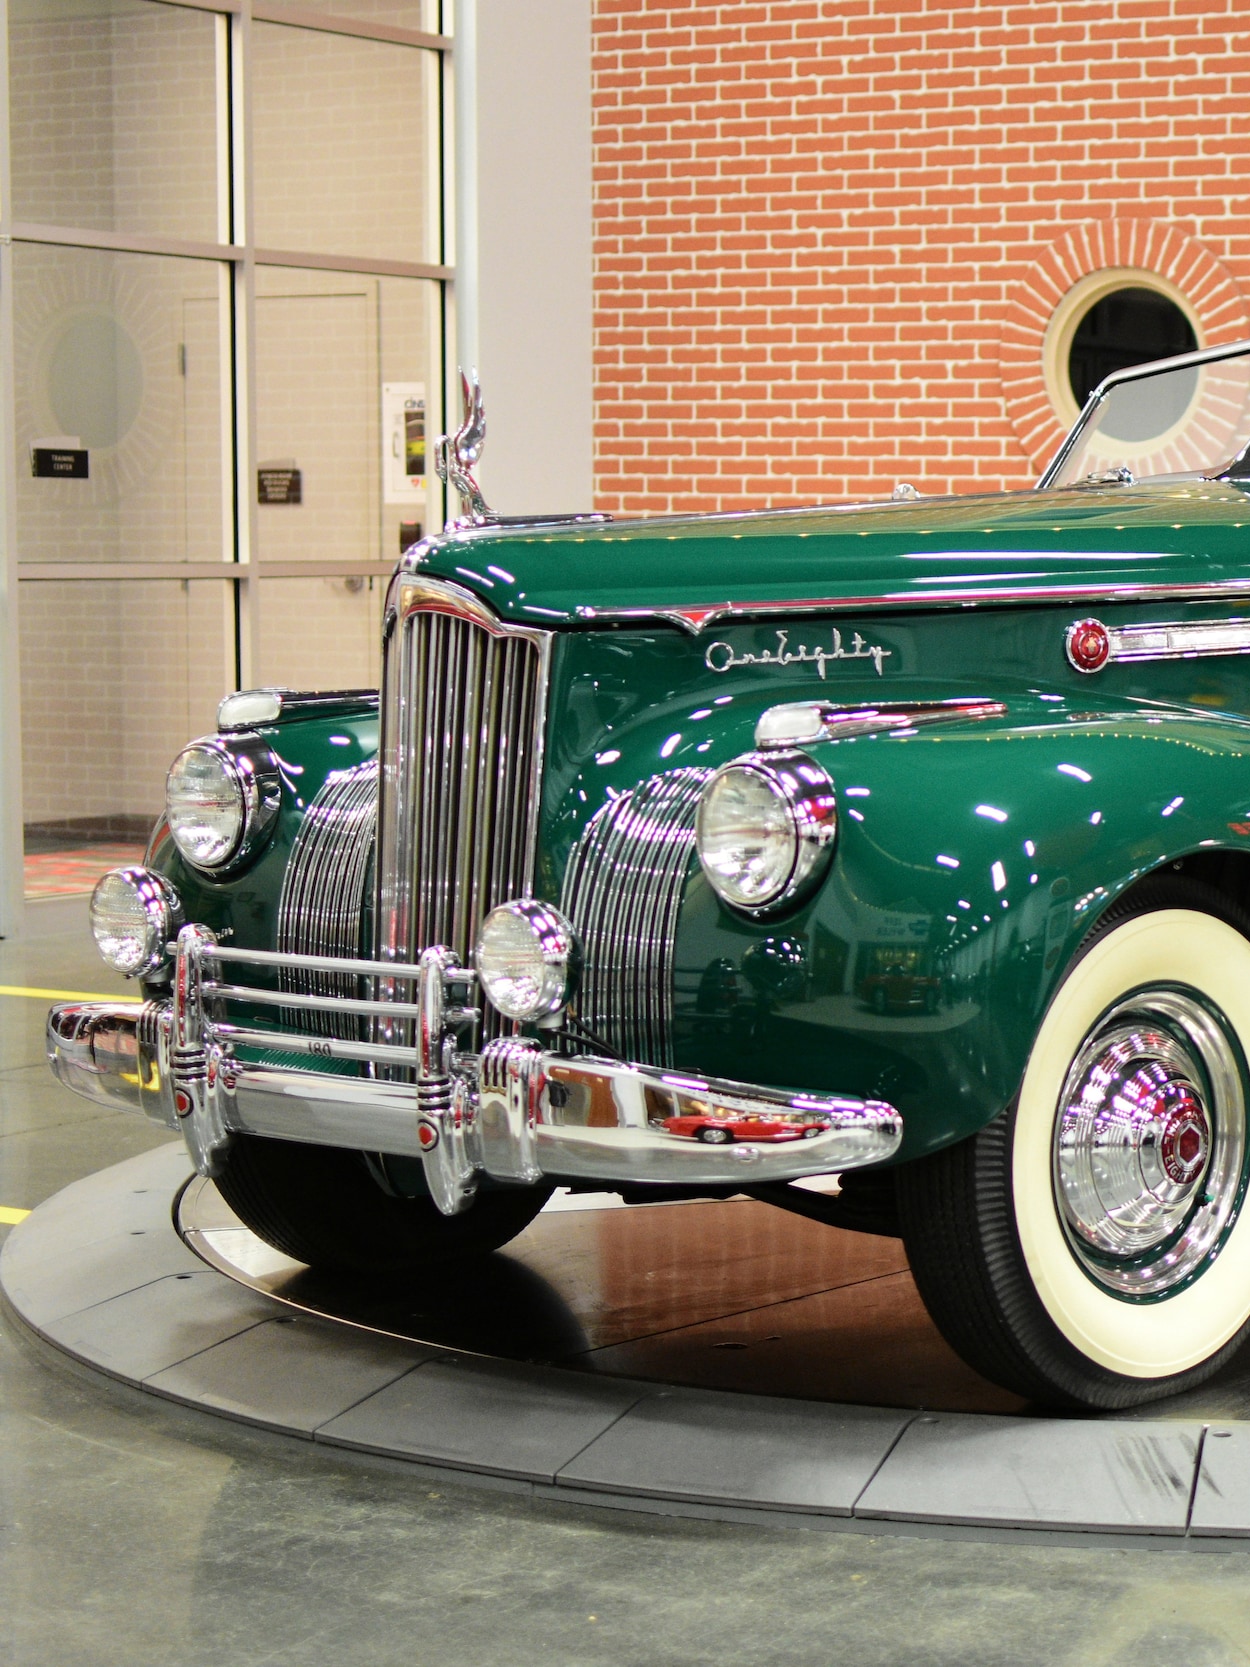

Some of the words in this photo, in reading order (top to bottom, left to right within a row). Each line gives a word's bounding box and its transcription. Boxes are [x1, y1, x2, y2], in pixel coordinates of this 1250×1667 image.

[51, 454, 75, 463] TRAINING
[53, 463, 73, 471] CENTER
[308, 1041, 332, 1057] 180
